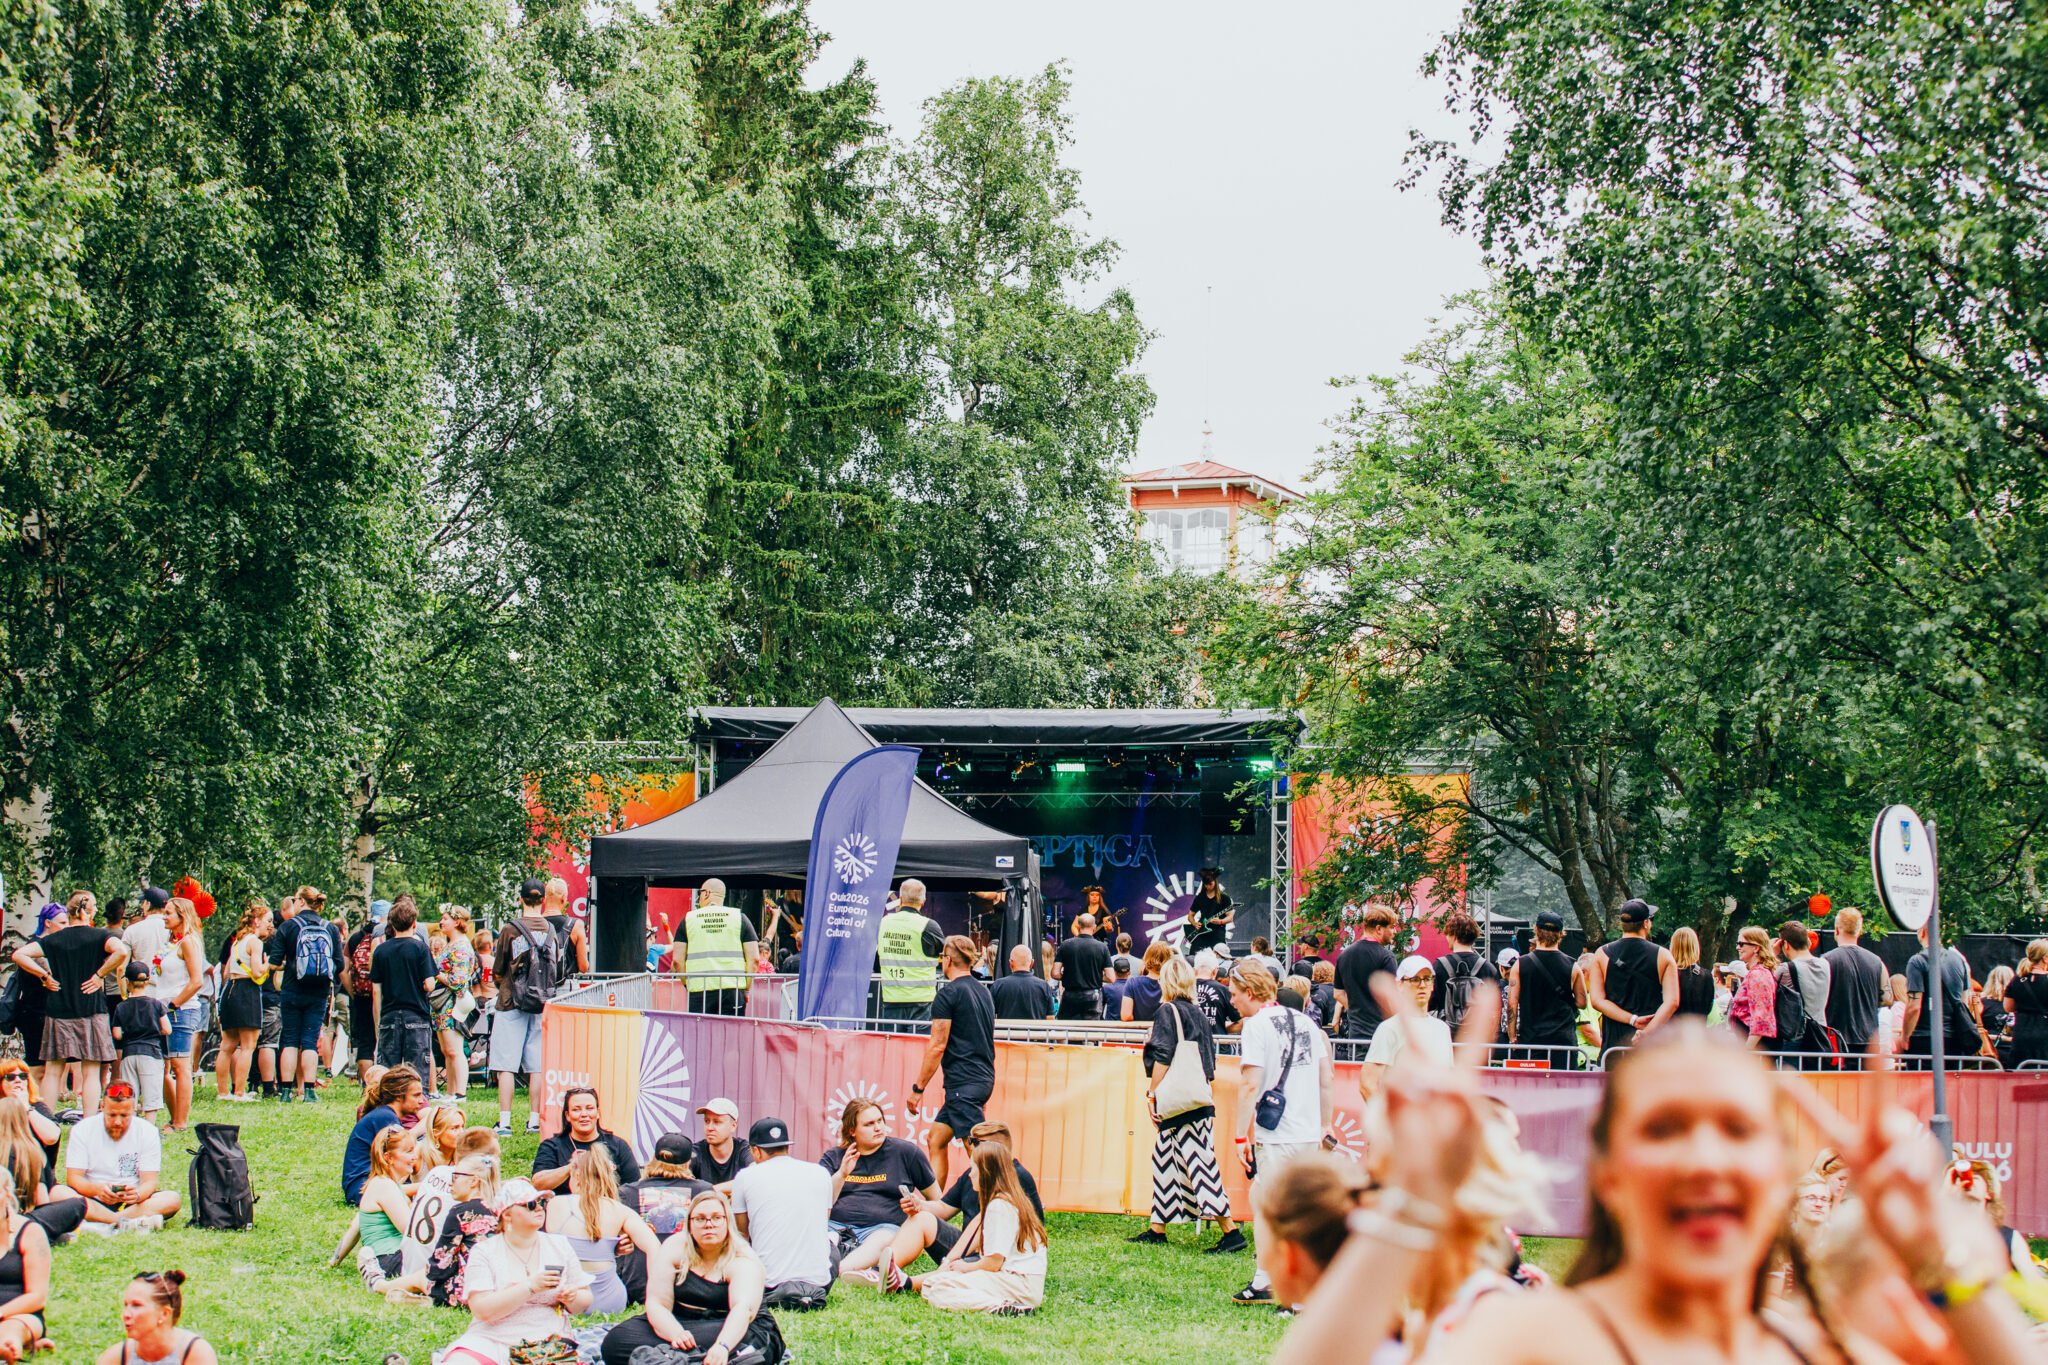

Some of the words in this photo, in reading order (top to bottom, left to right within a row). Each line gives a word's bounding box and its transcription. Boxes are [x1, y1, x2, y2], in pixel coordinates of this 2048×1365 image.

[1895, 862, 1922, 877] ODESSA
[854, 919, 866, 929] of
[890, 968, 905, 979] 115
[545, 1069, 591, 1088] OULU
[1952, 1142, 2013, 1159] OULU
[407, 1193, 443, 1245] 18
